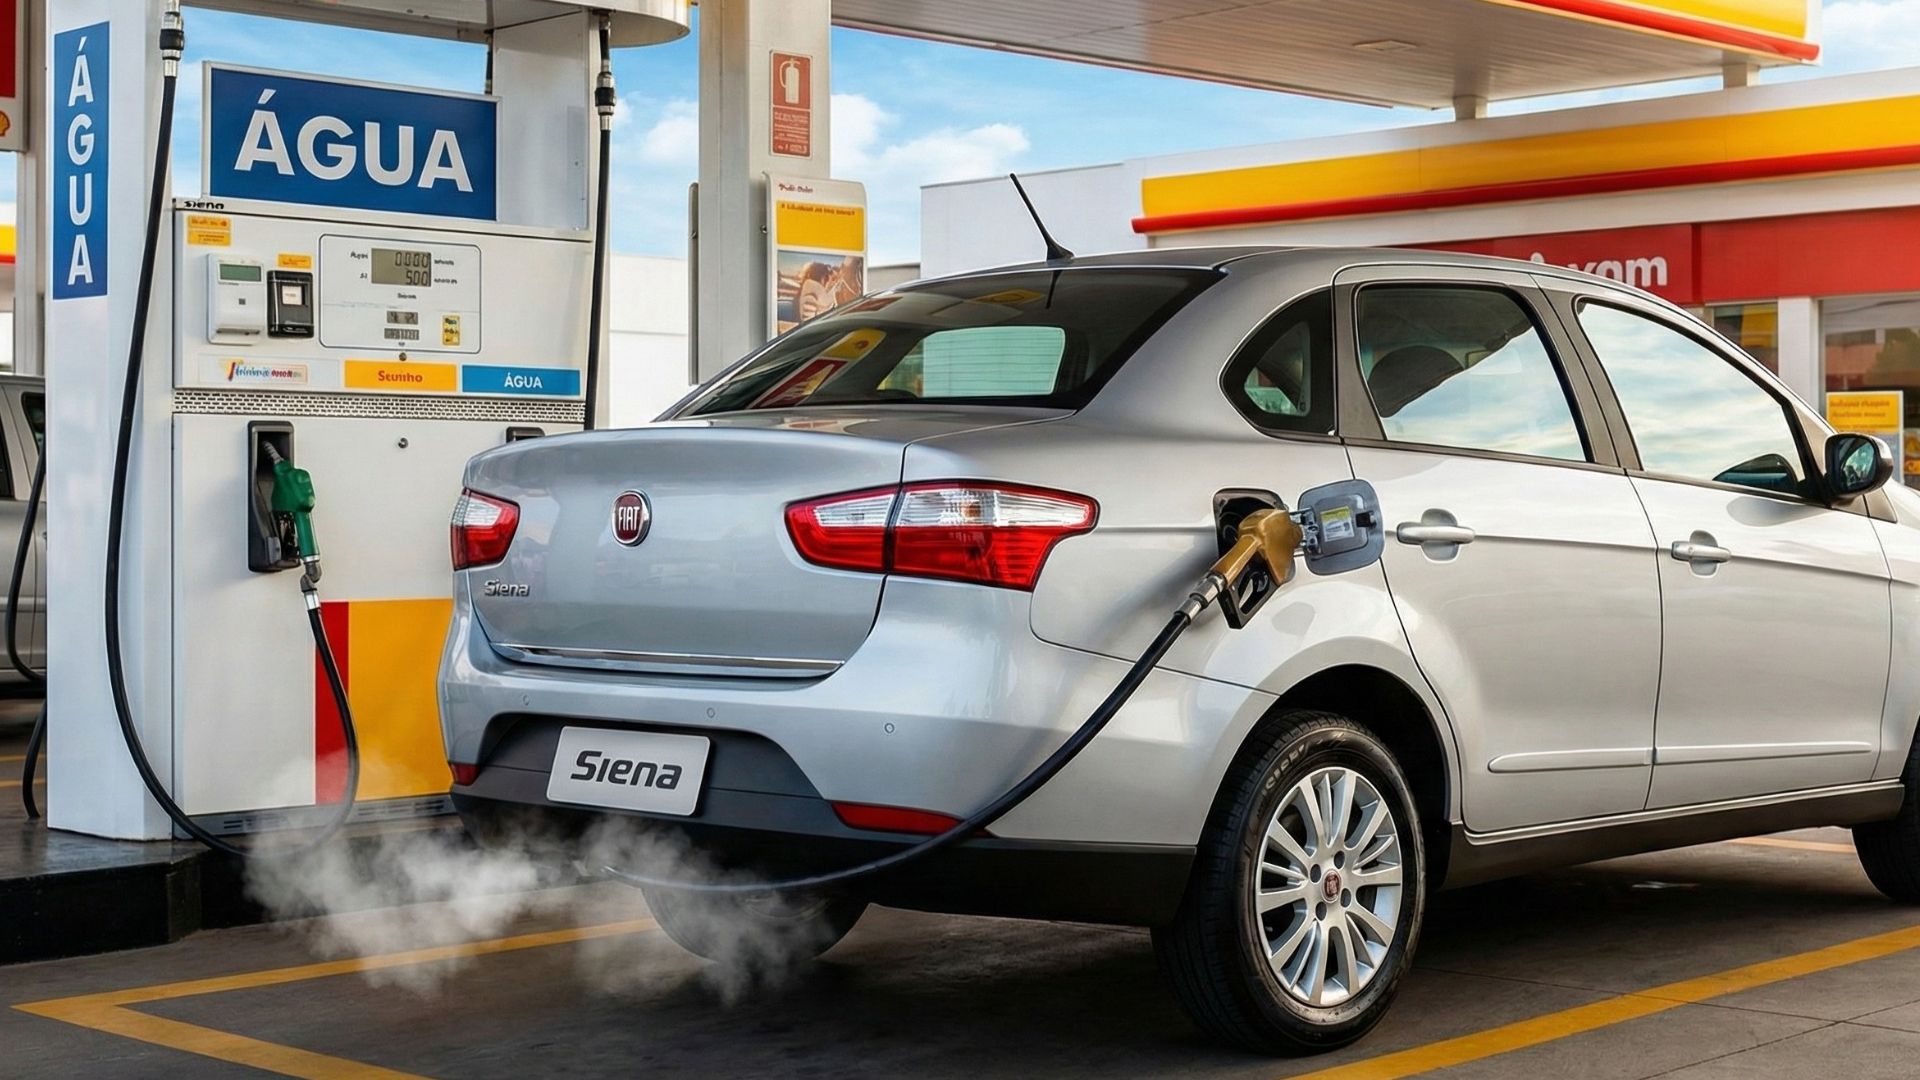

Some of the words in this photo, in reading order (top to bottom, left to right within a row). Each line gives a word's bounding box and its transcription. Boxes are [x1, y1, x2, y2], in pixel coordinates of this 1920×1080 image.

[234, 88, 474, 193] ÁGUA
[67, 36, 95, 285] ÁGUA
[504, 372, 543, 389] ÁGUA
[618, 506, 640, 531] FIAT
[484, 578, 530, 597] Siena
[570, 750, 683, 791] Siena
